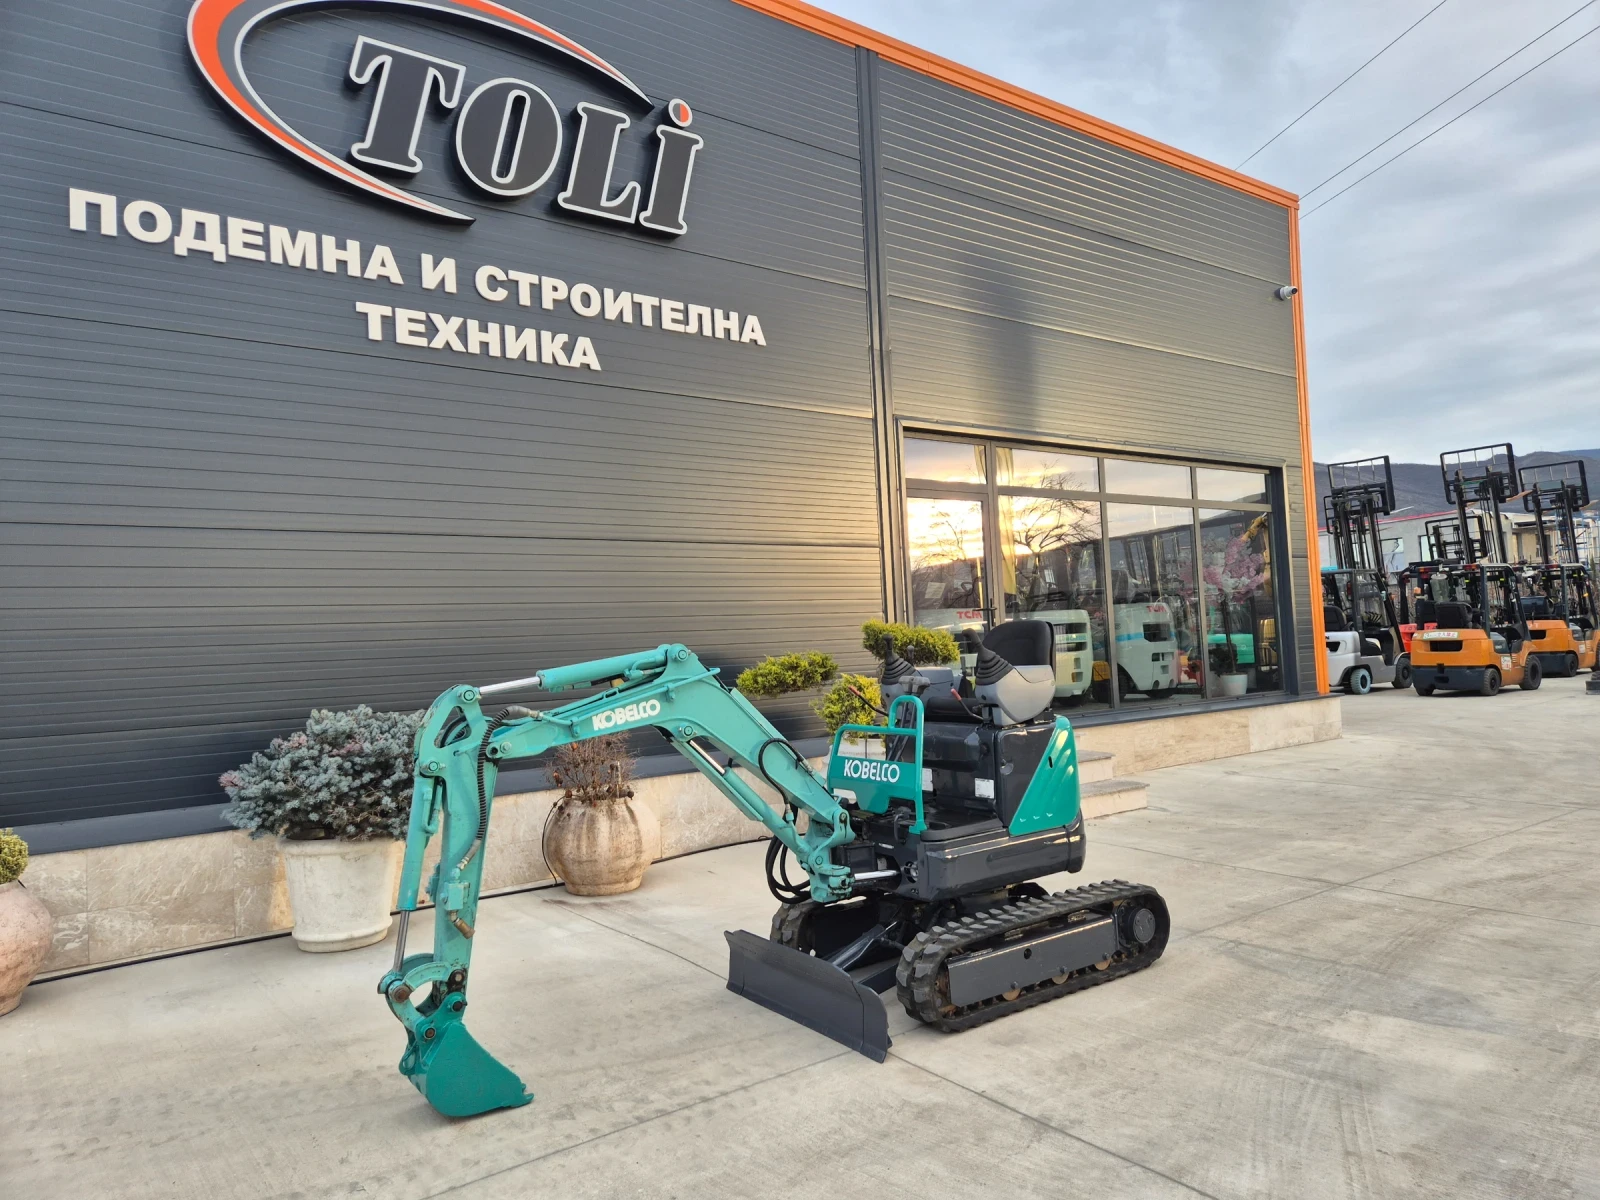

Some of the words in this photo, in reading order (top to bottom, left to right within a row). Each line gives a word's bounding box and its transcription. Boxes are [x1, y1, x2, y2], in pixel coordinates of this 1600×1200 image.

[68, 187, 405, 285] ПОДЕМНА
[420, 252, 457, 294] И
[475, 264, 767, 347] СТРОИТЕЛНА
[355, 301, 602, 371] ТЕХНИКА
[956, 611, 983, 619] TCM
[1146, 605, 1167, 613] TCM
[592, 699, 661, 731] KOBELCO
[844, 759, 900, 783] KOBELCO
